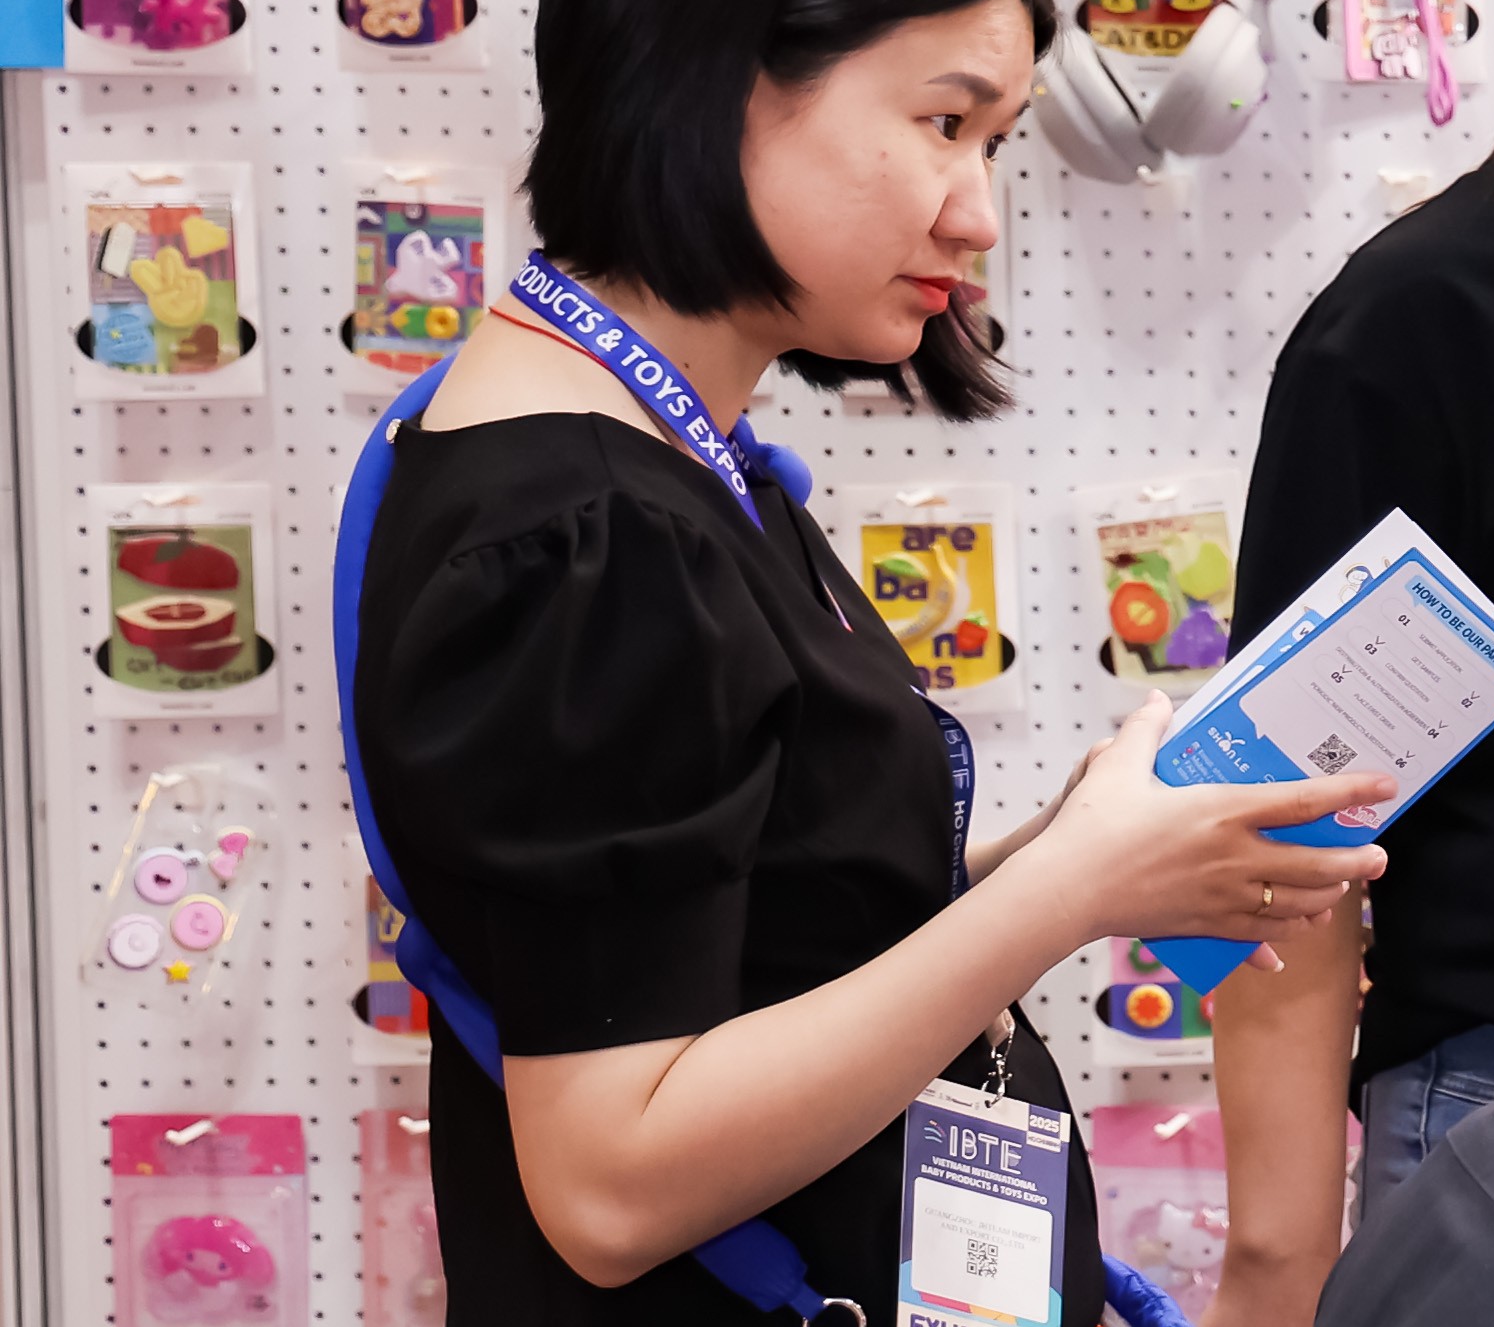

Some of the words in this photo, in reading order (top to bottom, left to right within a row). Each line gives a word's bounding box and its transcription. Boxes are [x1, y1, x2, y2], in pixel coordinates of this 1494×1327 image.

[515, 258, 605, 334] RODUCTS
[595, 328, 624, 352] &
[620, 344, 695, 418] TOYS
[686, 415, 748, 496] EXPO
[901, 524, 975, 551] are
[1397, 613, 1412, 628] 01
[1411, 582, 1440, 608] HOW
[1437, 602, 1453, 620] TO
[1449, 616, 1466, 633] BE
[1461, 627, 1484, 650] OUR
[1363, 642, 1379, 657] 03
[1330, 670, 1346, 685] 05
[1460, 697, 1474, 710] 02
[1427, 728, 1440, 740] 04
[1395, 757, 1408, 769] 06
[953, 800, 966, 829] HO
[1029, 1114, 1060, 1134] 2025
[949, 1125, 1023, 1175] IBTE
[920, 1163, 947, 1179] BABY
[945, 1171, 993, 1193] PRODUCTS
[1000, 1185, 1024, 1200] TOYS
[1023, 1192, 1049, 1207] EXPO
[932, 1155, 973, 1174] VIETNAM
[971, 1167, 1038, 1193] INTERNATIONAL
